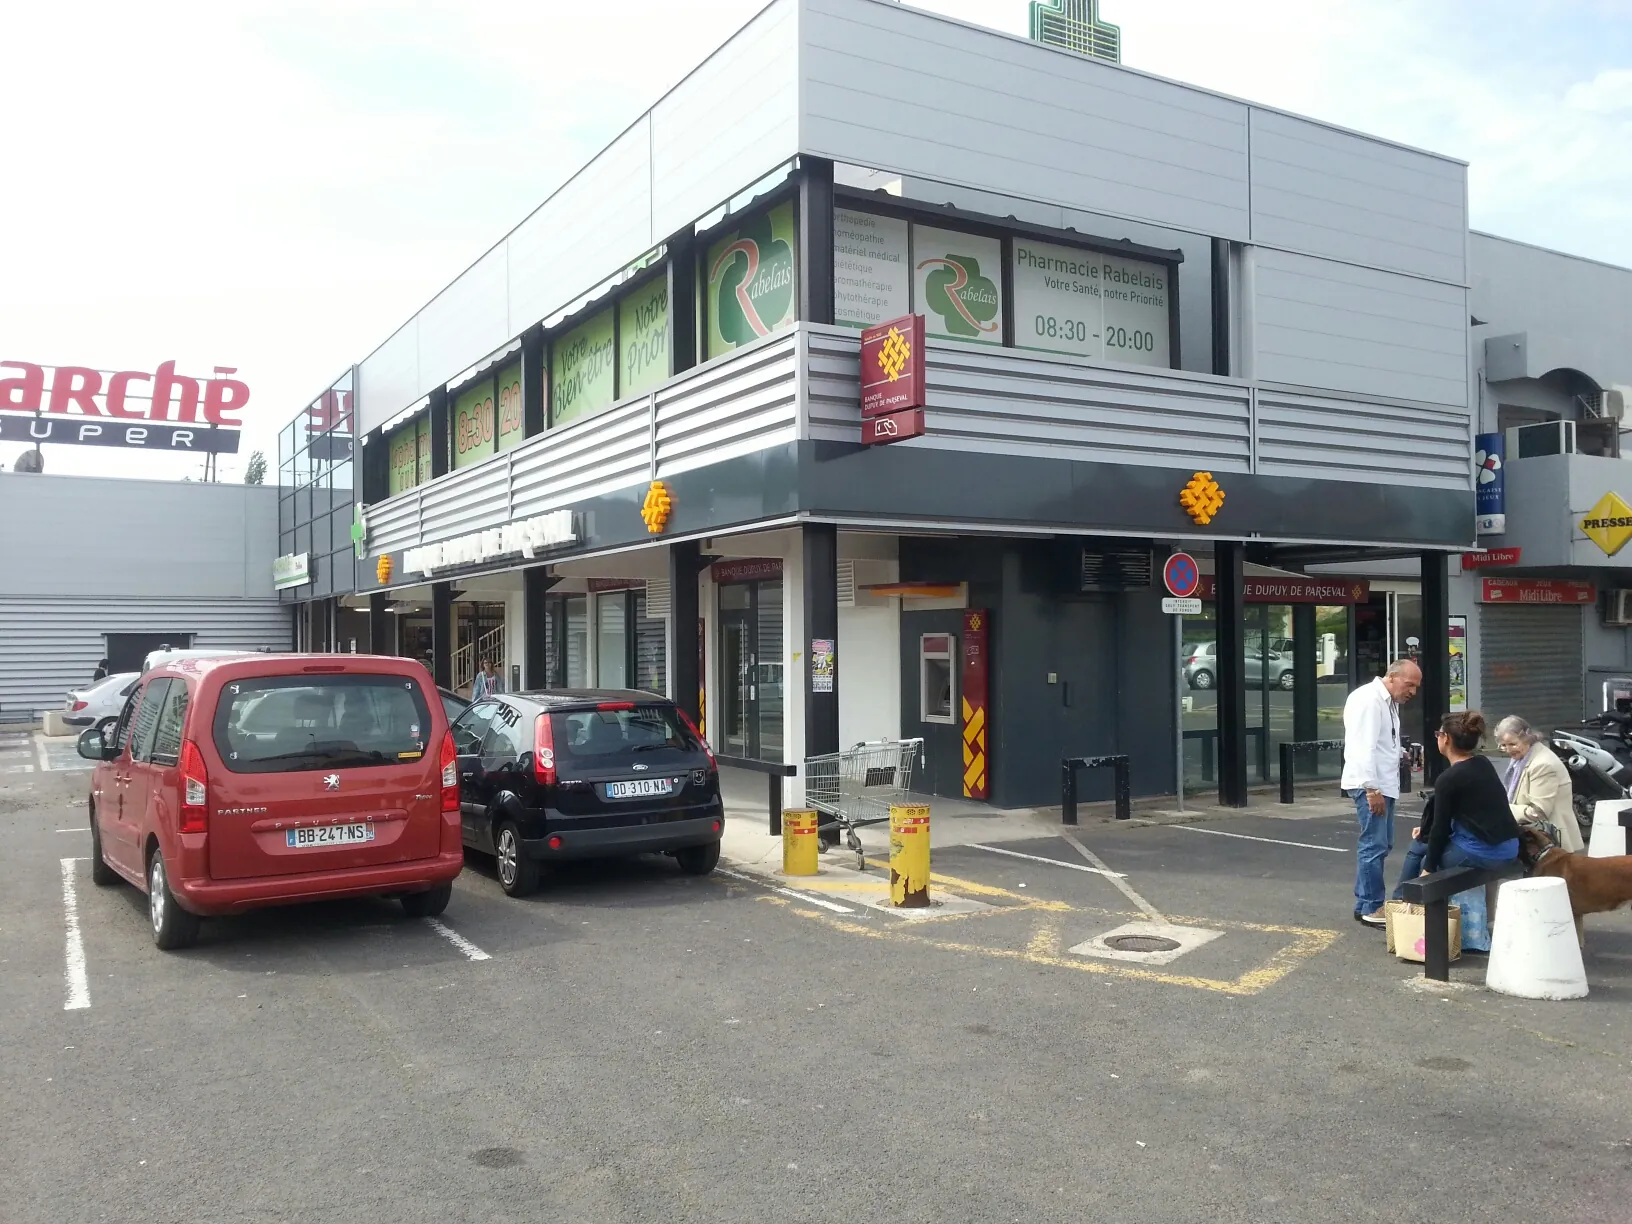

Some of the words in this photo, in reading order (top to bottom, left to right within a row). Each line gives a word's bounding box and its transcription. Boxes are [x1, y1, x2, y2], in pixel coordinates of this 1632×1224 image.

[868, 249, 900, 263] médical
[1017, 248, 1099, 279] Pharmacie
[1103, 264, 1163, 290] Rabelais
[916, 258, 998, 333] Rabelais
[1044, 275, 1070, 291] Votre
[1072, 281, 1102, 299] Santé,
[1104, 287, 1128, 301] notre
[1131, 291, 1164, 307] Priorité
[635, 288, 668, 339] Notre
[1035, 315, 1086, 342] 08:30
[1106, 326, 1154, 352] 20:00
[561, 336, 588, 376] Votre
[864, 392, 882, 403] BANQUE
[457, 396, 494, 455] 8:30
[500, 380, 521, 438] 20
[1583, 517, 1632, 529] PRESSE
[1472, 554, 1491, 562] Midi
[1492, 552, 1514, 562] Libre
[1255, 585, 1288, 596] DUPUY
[1290, 585, 1302, 596] DE
[1305, 585, 1347, 600] PARSEVAL
[1519, 589, 1539, 602] Midi
[1539, 590, 1563, 602] Libre
[613, 779, 666, 796] DD-310-NA
[217, 807, 268, 816] PARTNER
[298, 825, 364, 844] BB-247-NS
